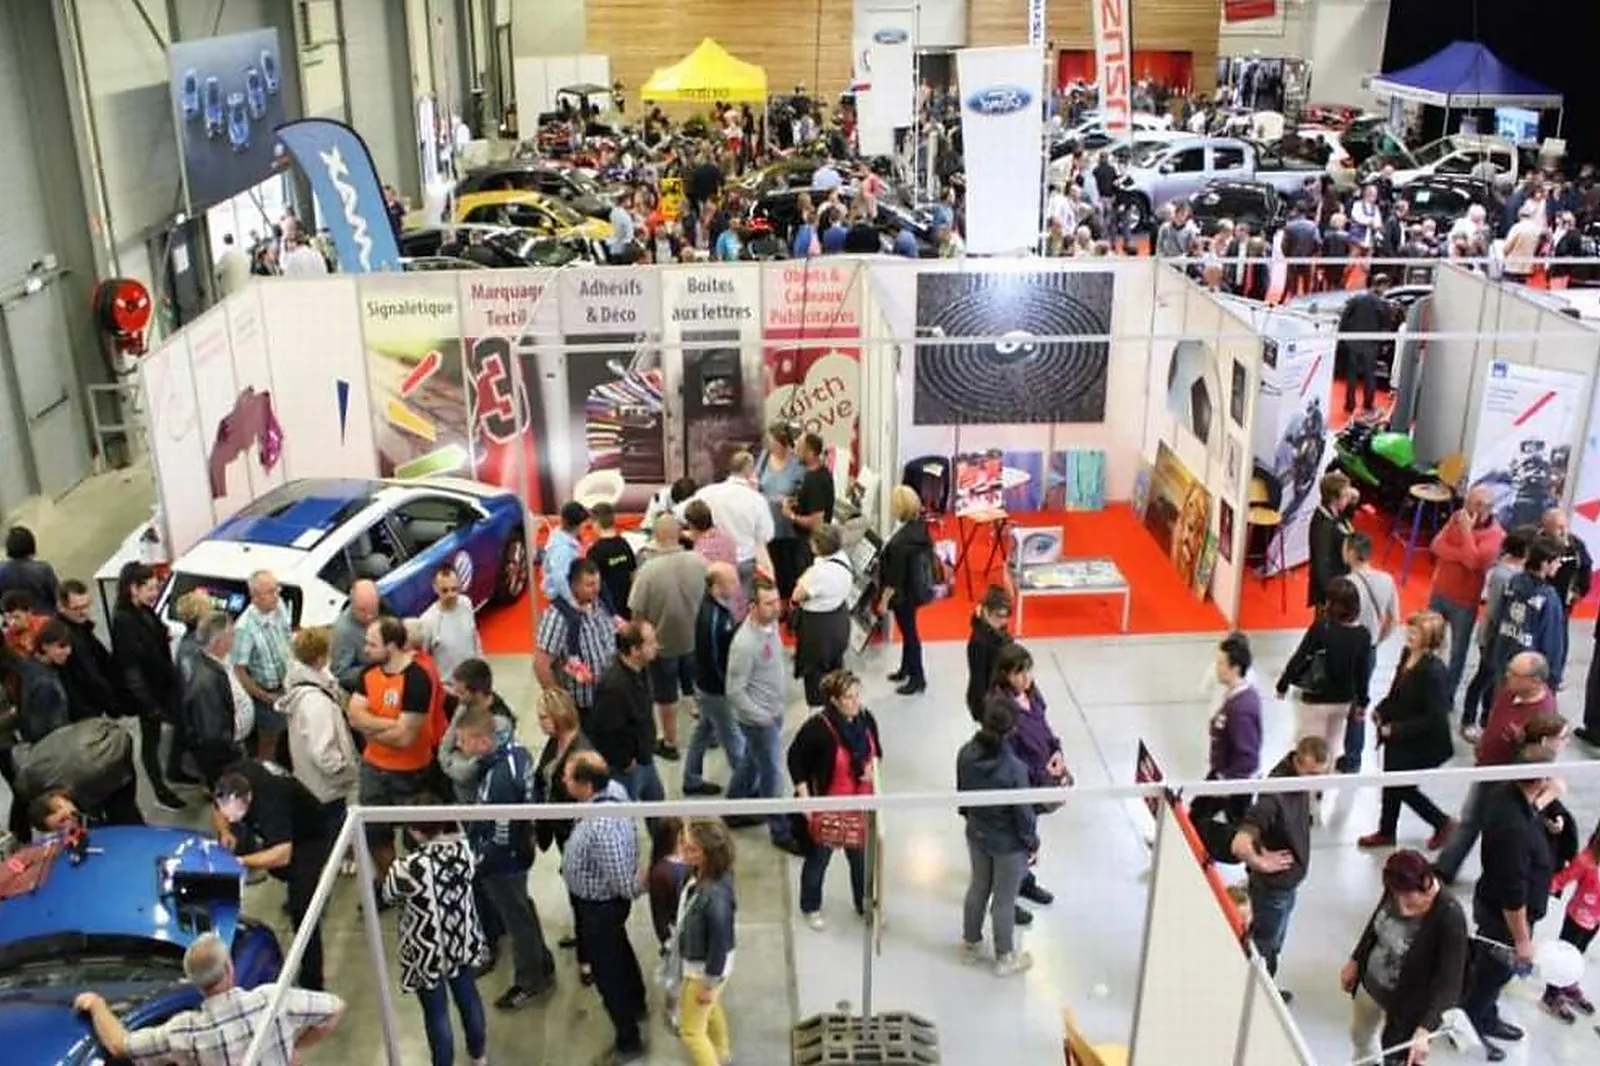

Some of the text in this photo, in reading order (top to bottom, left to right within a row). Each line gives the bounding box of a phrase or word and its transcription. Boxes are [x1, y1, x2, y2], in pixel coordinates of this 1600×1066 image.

[484, 309, 528, 326] Textil
[585, 306, 597, 323] &
[672, 303, 752, 321] aux lettres
[803, 399, 853, 433] ove
